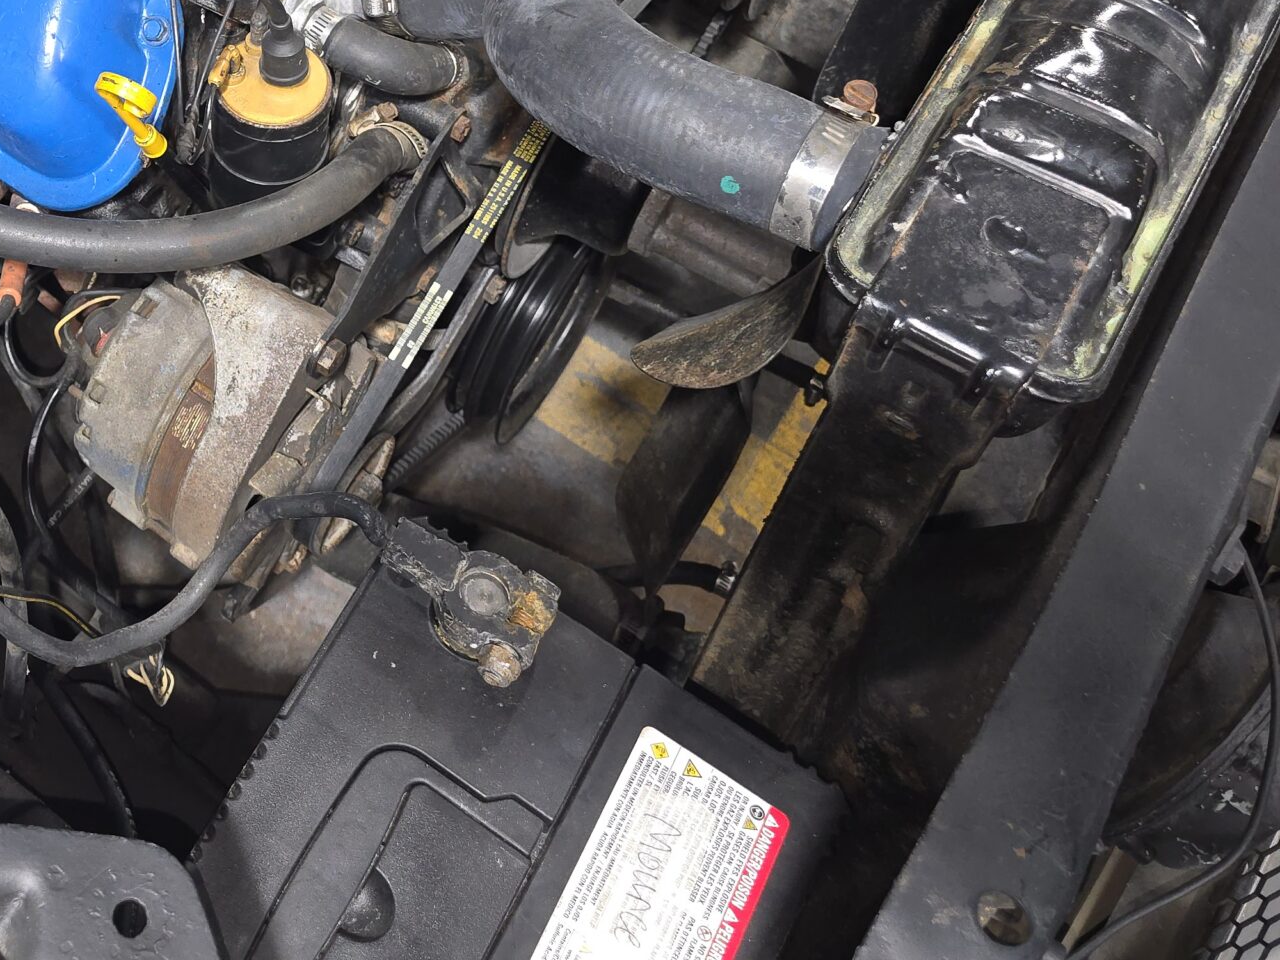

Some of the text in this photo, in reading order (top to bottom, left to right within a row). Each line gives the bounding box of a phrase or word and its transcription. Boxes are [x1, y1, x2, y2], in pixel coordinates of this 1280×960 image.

[500, 159, 513, 176] MADE
[508, 163, 521, 181] MADE
[496, 174, 504, 183] IN
[504, 179, 512, 187] IN
[620, 750, 647, 799] INMEDIATAMENTE
[656, 765, 668, 783] FLUSH
[703, 774, 718, 798] CAUSAR
[725, 785, 734, 796] OU
[613, 798, 624, 812] CON
[707, 798, 718, 814] LOS
[716, 794, 730, 817] RENDRE
[740, 795, 749, 806] OR
[571, 755, 654, 922] CONSULTER UN MÉDECIN RAPIDEMENT ENJUAGE LOS OJOS
[594, 830, 608, 852] ACUDA
[725, 830, 734, 840] SE
[687, 790, 742, 903] LES GAZ EXPLOSIFS PEUVENT BLESSER
[738, 835, 753, 859] SHIELD
[584, 850, 599, 874] RAPIDO
[710, 839, 732, 874] PROTÉGER
[701, 830, 746, 920] GASES CAN CAUSE BLINDNESS
[728, 826, 777, 910] DANGER/POISON
[577, 872, 588, 888] CON
[705, 872, 716, 886] LES
[574, 886, 582, 894] EL
[714, 876, 737, 914] EXPLOSIVE
[562, 893, 578, 919] MEDICO
[684, 916, 696, 931] PAS
[696, 943, 707, 956] NO
